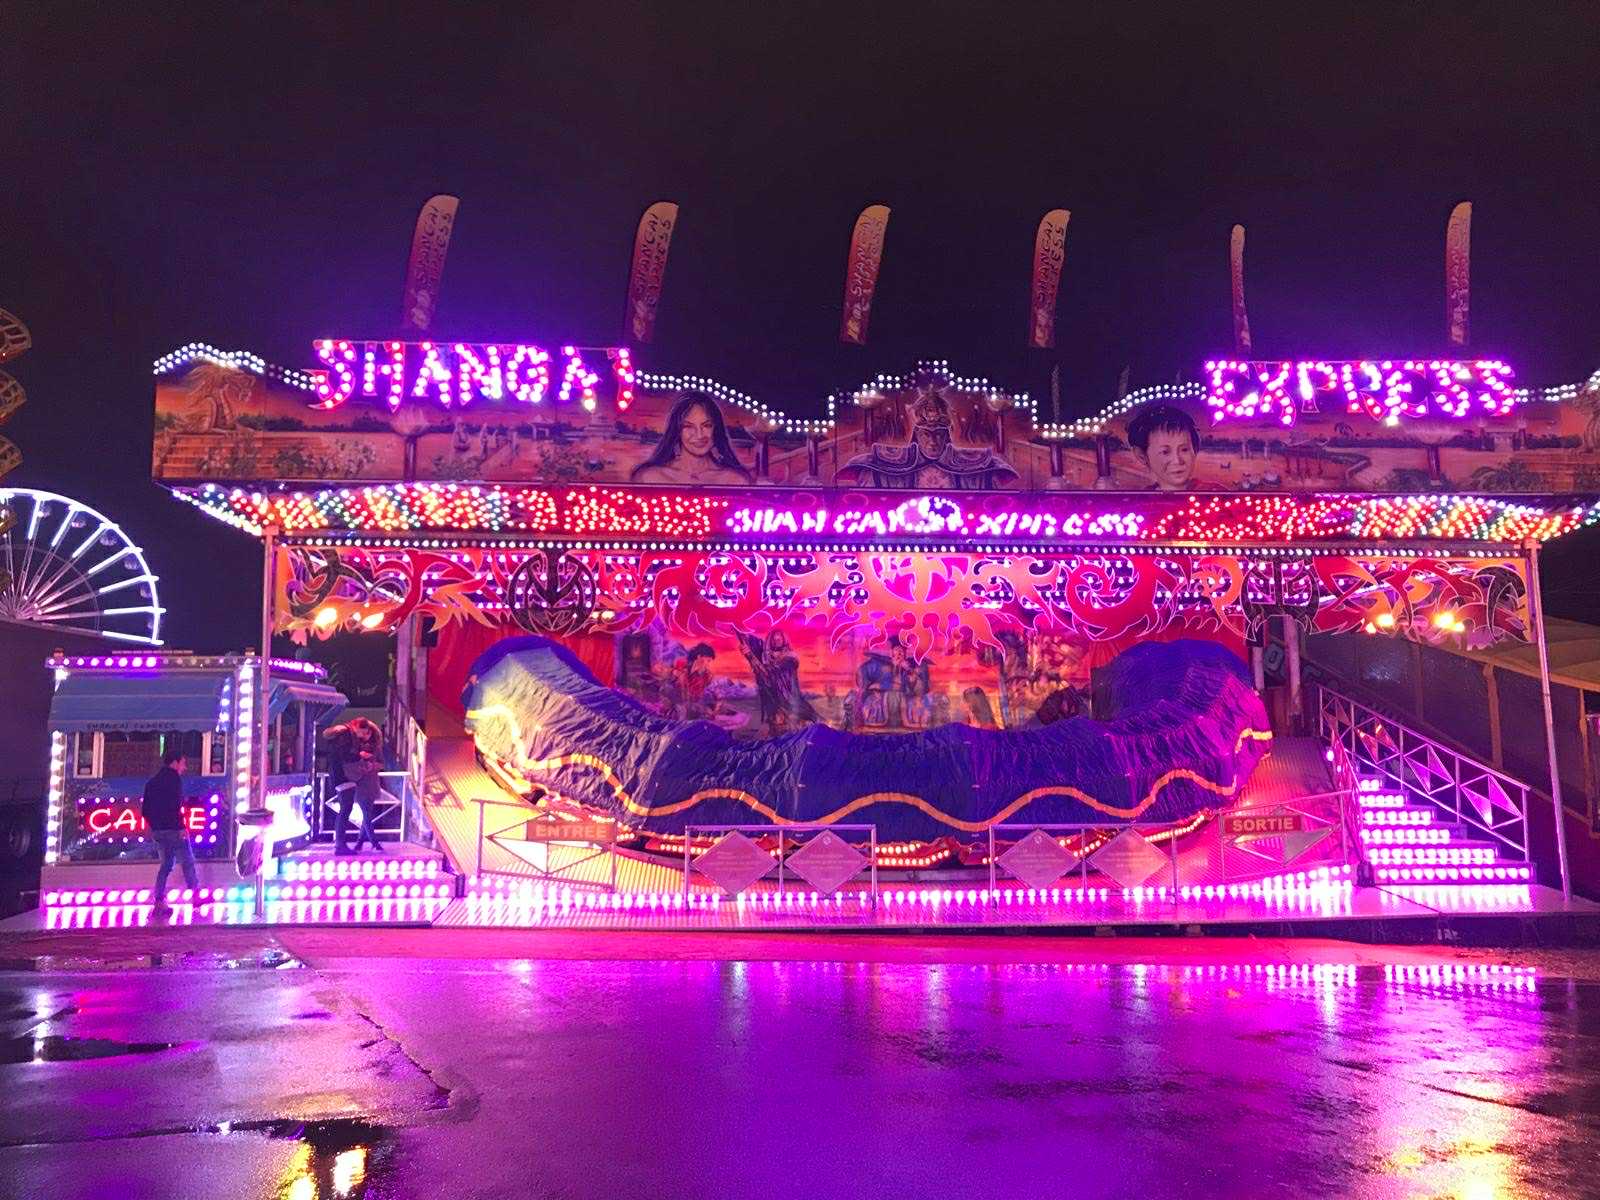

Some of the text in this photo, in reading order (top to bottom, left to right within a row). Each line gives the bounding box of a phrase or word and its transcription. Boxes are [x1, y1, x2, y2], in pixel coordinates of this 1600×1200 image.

[308, 339, 1516, 428] SHANGAI EXPRESS
[89, 807, 206, 831] CAIE
[1232, 817, 1294, 832] SORTIE
